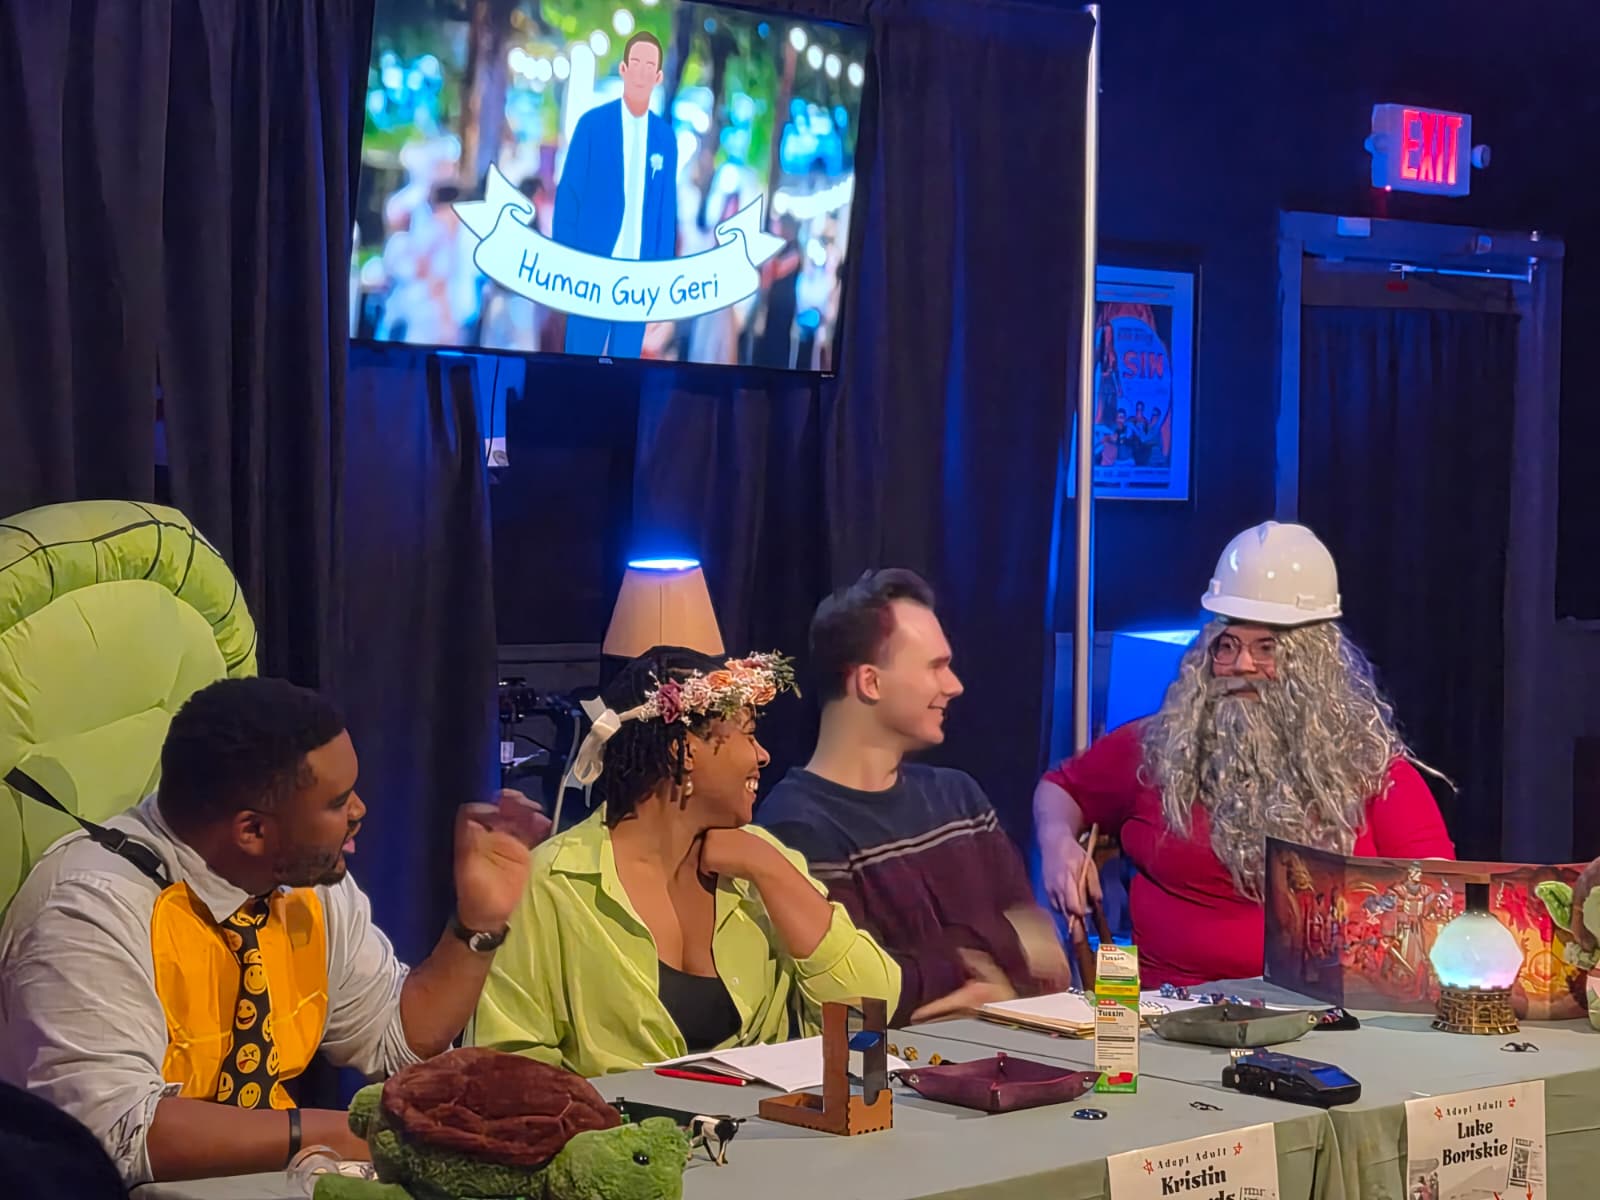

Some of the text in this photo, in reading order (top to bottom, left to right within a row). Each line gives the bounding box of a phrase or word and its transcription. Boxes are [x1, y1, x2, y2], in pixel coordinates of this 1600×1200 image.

[1400, 109, 1463, 185] EXIT
[518, 248, 719, 315] Human Guy Geri
[1457, 1119, 1494, 1140] Luke
[1195, 1147, 1226, 1162] Adult
[1442, 1138, 1508, 1166] Boriskie
[1161, 1165, 1227, 1196] Kristin
